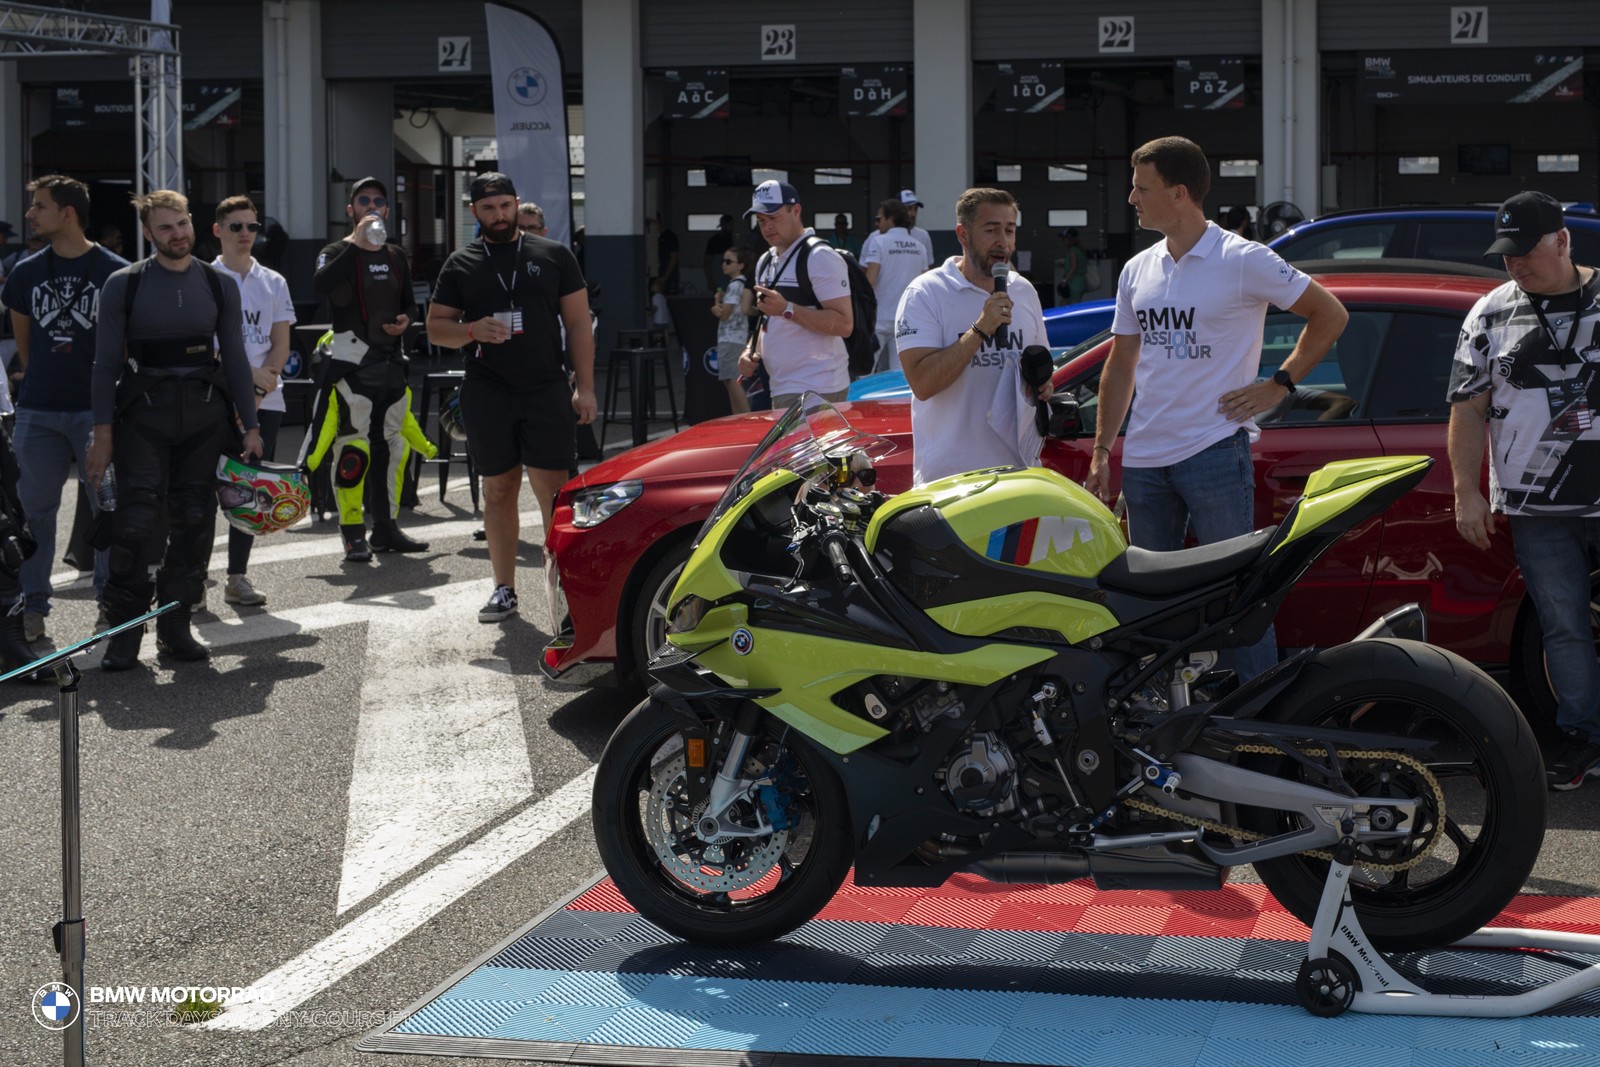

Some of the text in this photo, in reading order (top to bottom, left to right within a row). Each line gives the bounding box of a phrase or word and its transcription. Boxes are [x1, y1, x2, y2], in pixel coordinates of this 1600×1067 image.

[1454, 11, 1483, 39] 21
[1101, 21, 1132, 48] 22
[763, 29, 794, 56] 23
[440, 41, 470, 67] 24
[1408, 73, 1531, 84] SIMULATEURS DE CONDUITE
[854, 88, 864, 100] D
[881, 88, 891, 100] H
[1190, 81, 1200, 94] P
[1217, 80, 1227, 93] Z
[677, 90, 688, 103] A
[704, 90, 714, 103] C
[94, 105, 134, 113] BOUTIQUE
[894, 240, 917, 249] TEAM
[32, 286, 100, 323] CANADA
[1136, 307, 1195, 332] BMW
[1142, 331, 1197, 346] ASSION
[1164, 345, 1212, 360] TOUR
[1341, 925, 1361, 948] BMW
